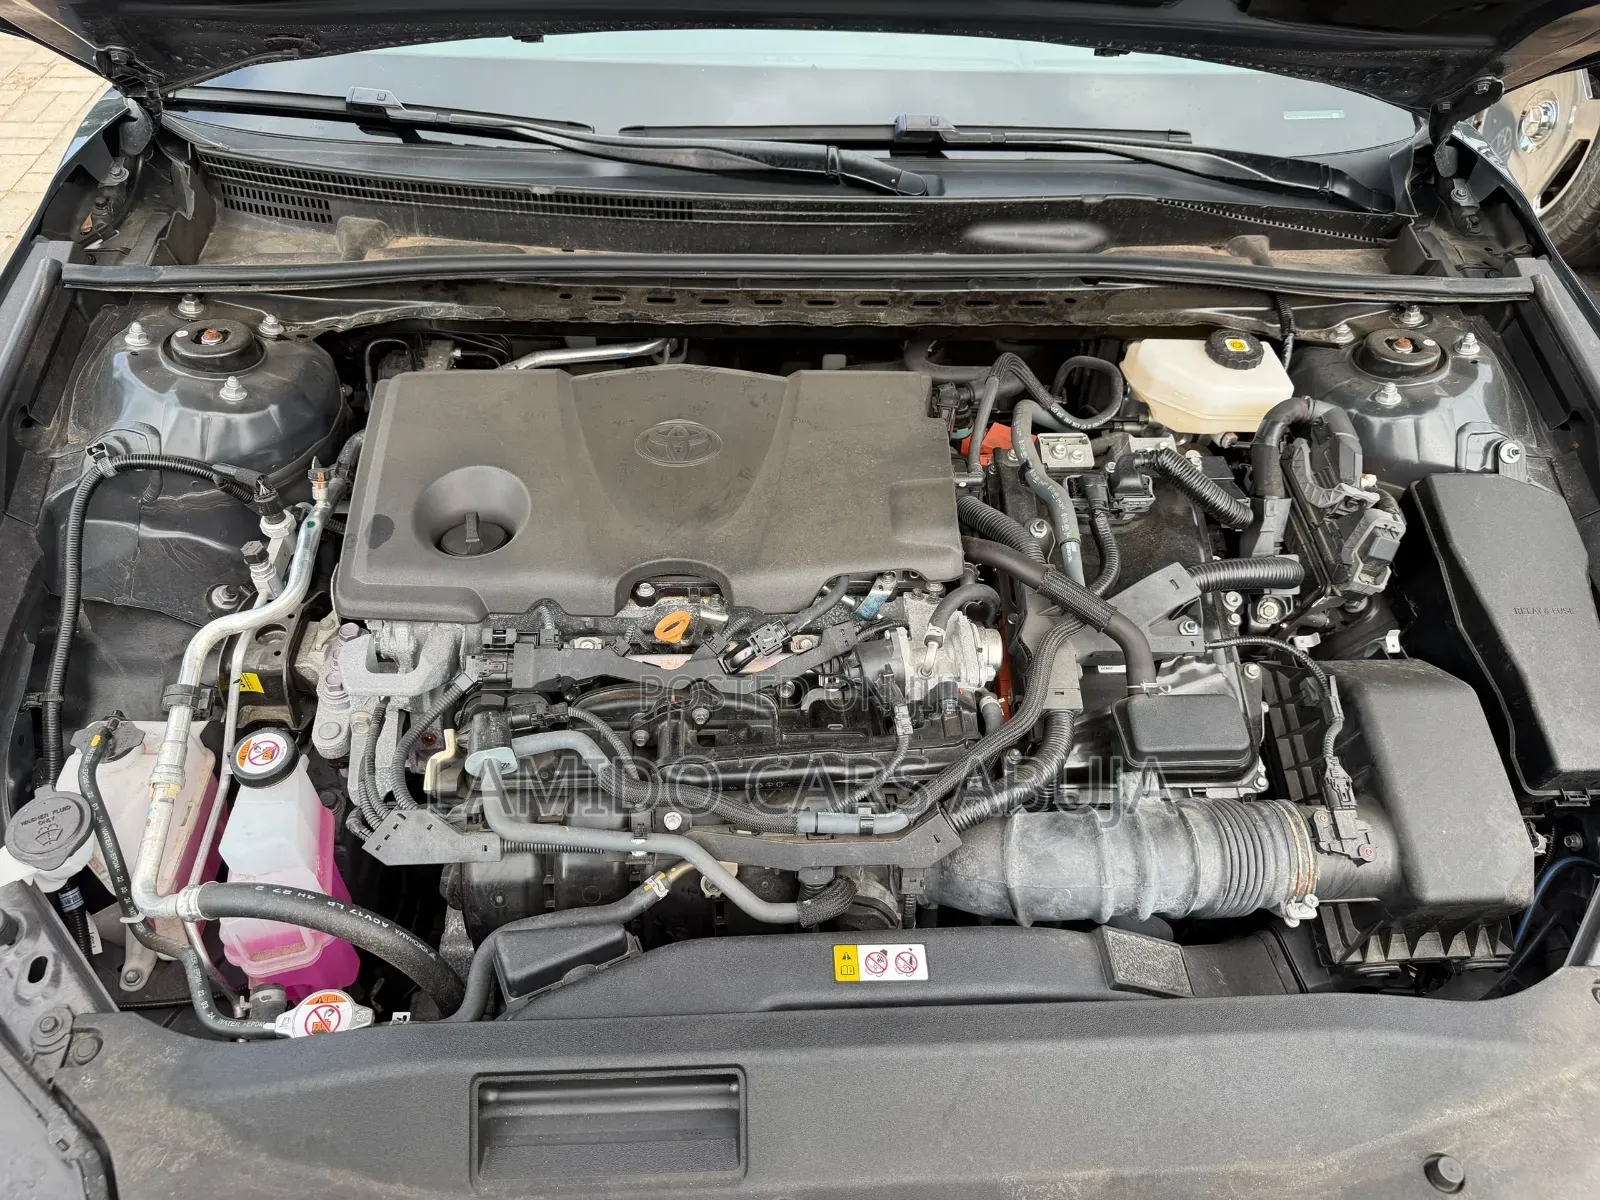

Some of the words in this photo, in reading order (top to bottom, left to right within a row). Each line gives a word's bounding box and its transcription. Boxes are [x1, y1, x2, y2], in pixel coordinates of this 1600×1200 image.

[1513, 607, 1543, 615] RELAY
[20, 812, 49, 826] WASHER
[52, 804, 72, 815] FLUID
[37, 815, 56, 826] ONLY
[101, 826, 113, 849] WATER
[327, 900, 345, 910] LP
[349, 908, 389, 929] ACV17
[394, 927, 430, 954] YOKOHAMA
[206, 1011, 217, 1020] 24
[217, 1018, 241, 1028] WATER
